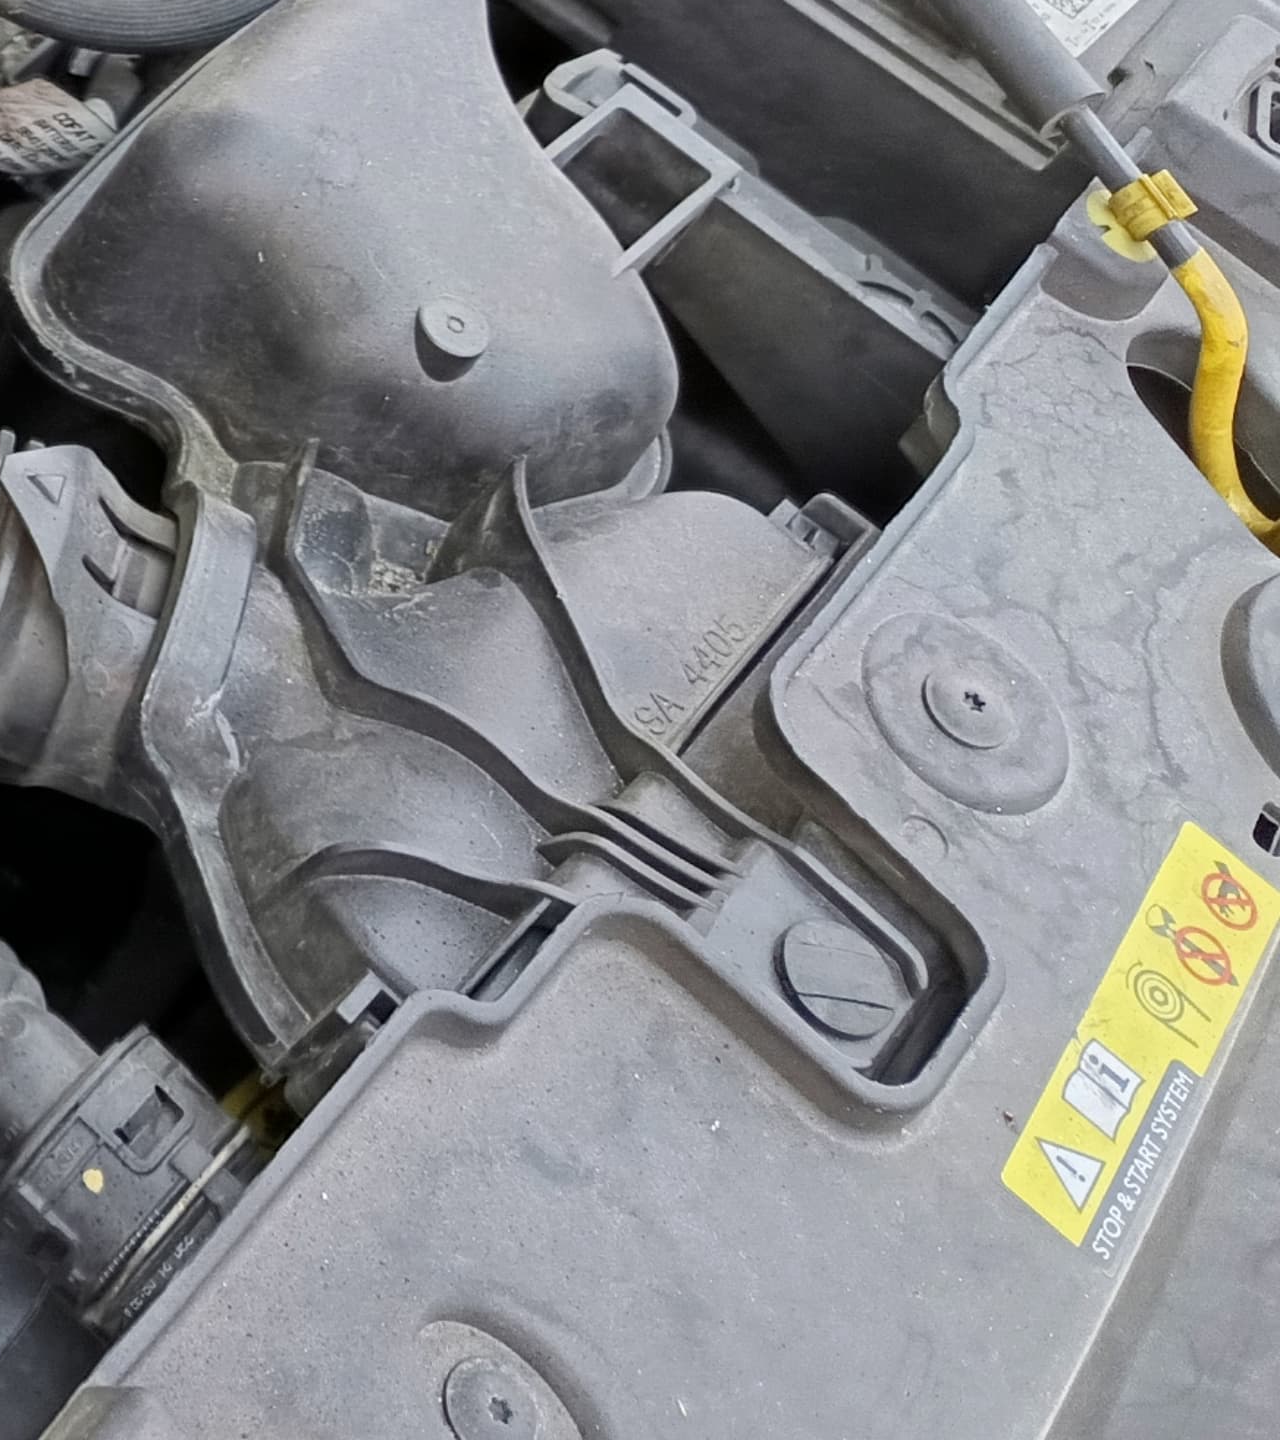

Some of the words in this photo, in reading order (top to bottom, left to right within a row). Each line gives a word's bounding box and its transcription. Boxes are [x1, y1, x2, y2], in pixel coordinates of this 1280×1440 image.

[633, 691, 686, 736] SA
[683, 613, 746, 684] 4405
[1151, 1069, 1195, 1141] SYSTEM
[1123, 1133, 1162, 1196] START
[1092, 1204, 1127, 1260] STOP
[1116, 1192, 1137, 1212] &
